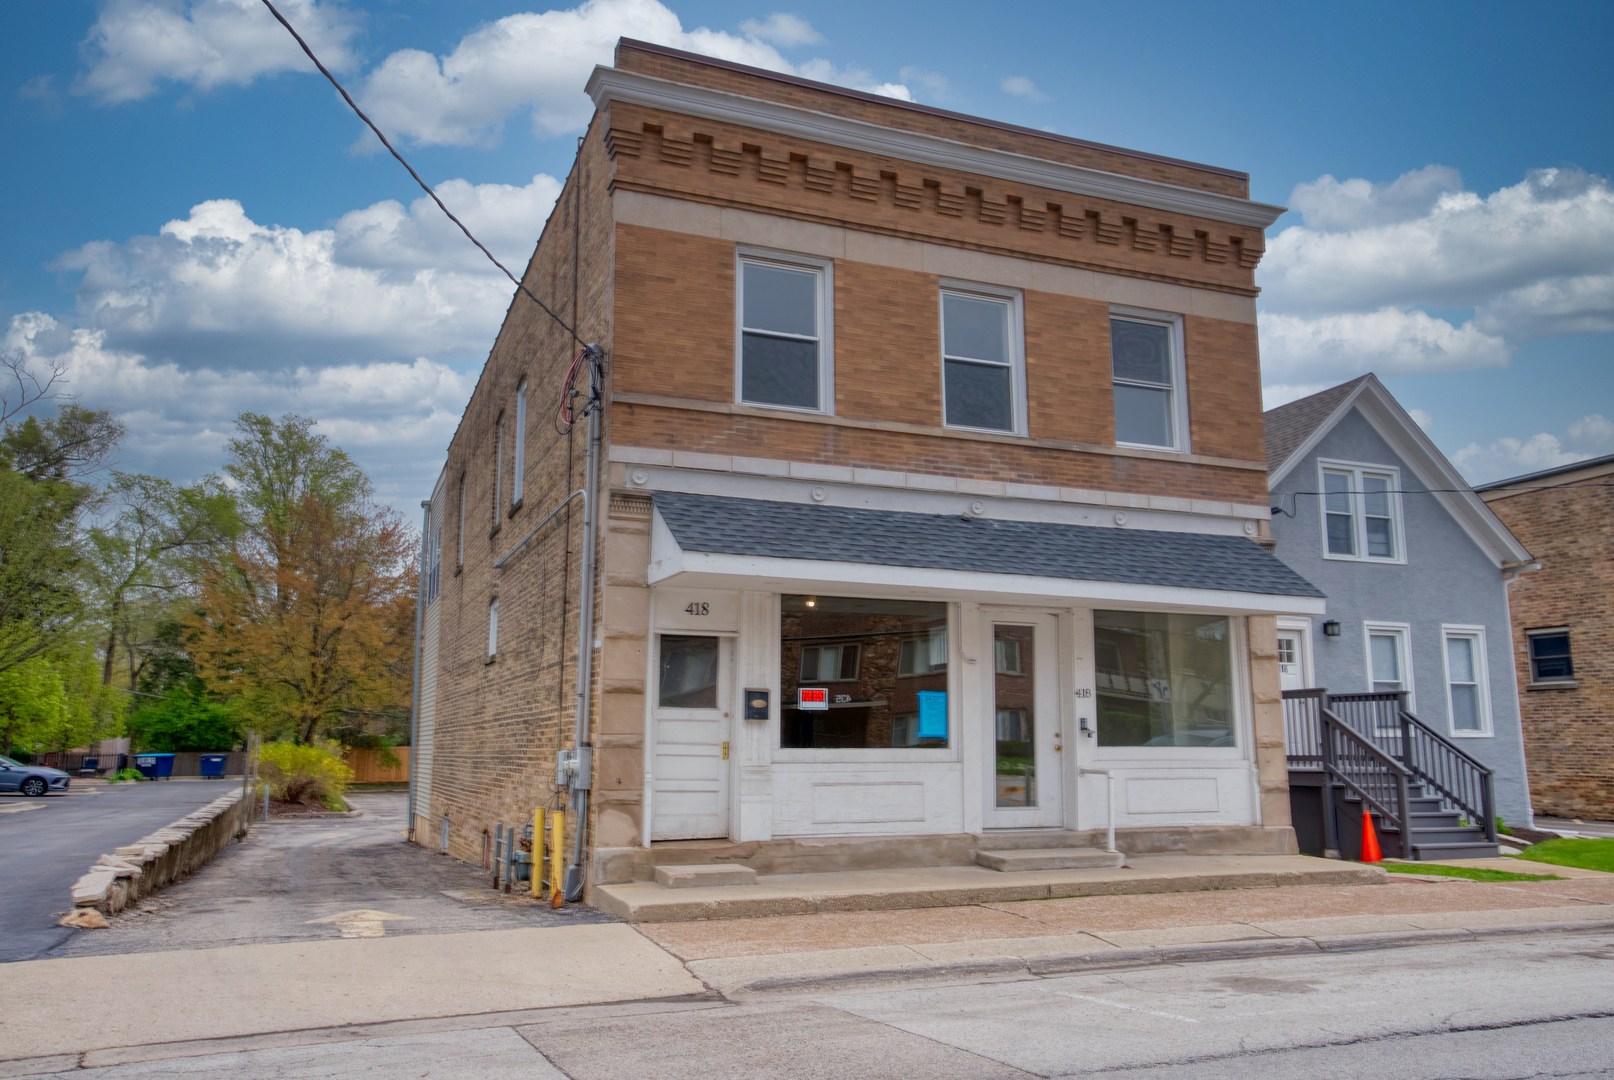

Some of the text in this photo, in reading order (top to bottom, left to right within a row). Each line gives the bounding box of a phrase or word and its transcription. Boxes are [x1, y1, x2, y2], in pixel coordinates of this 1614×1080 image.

[684, 601, 710, 616] 418
[1279, 664, 1288, 673] 16
[1074, 688, 1092, 699] 418
